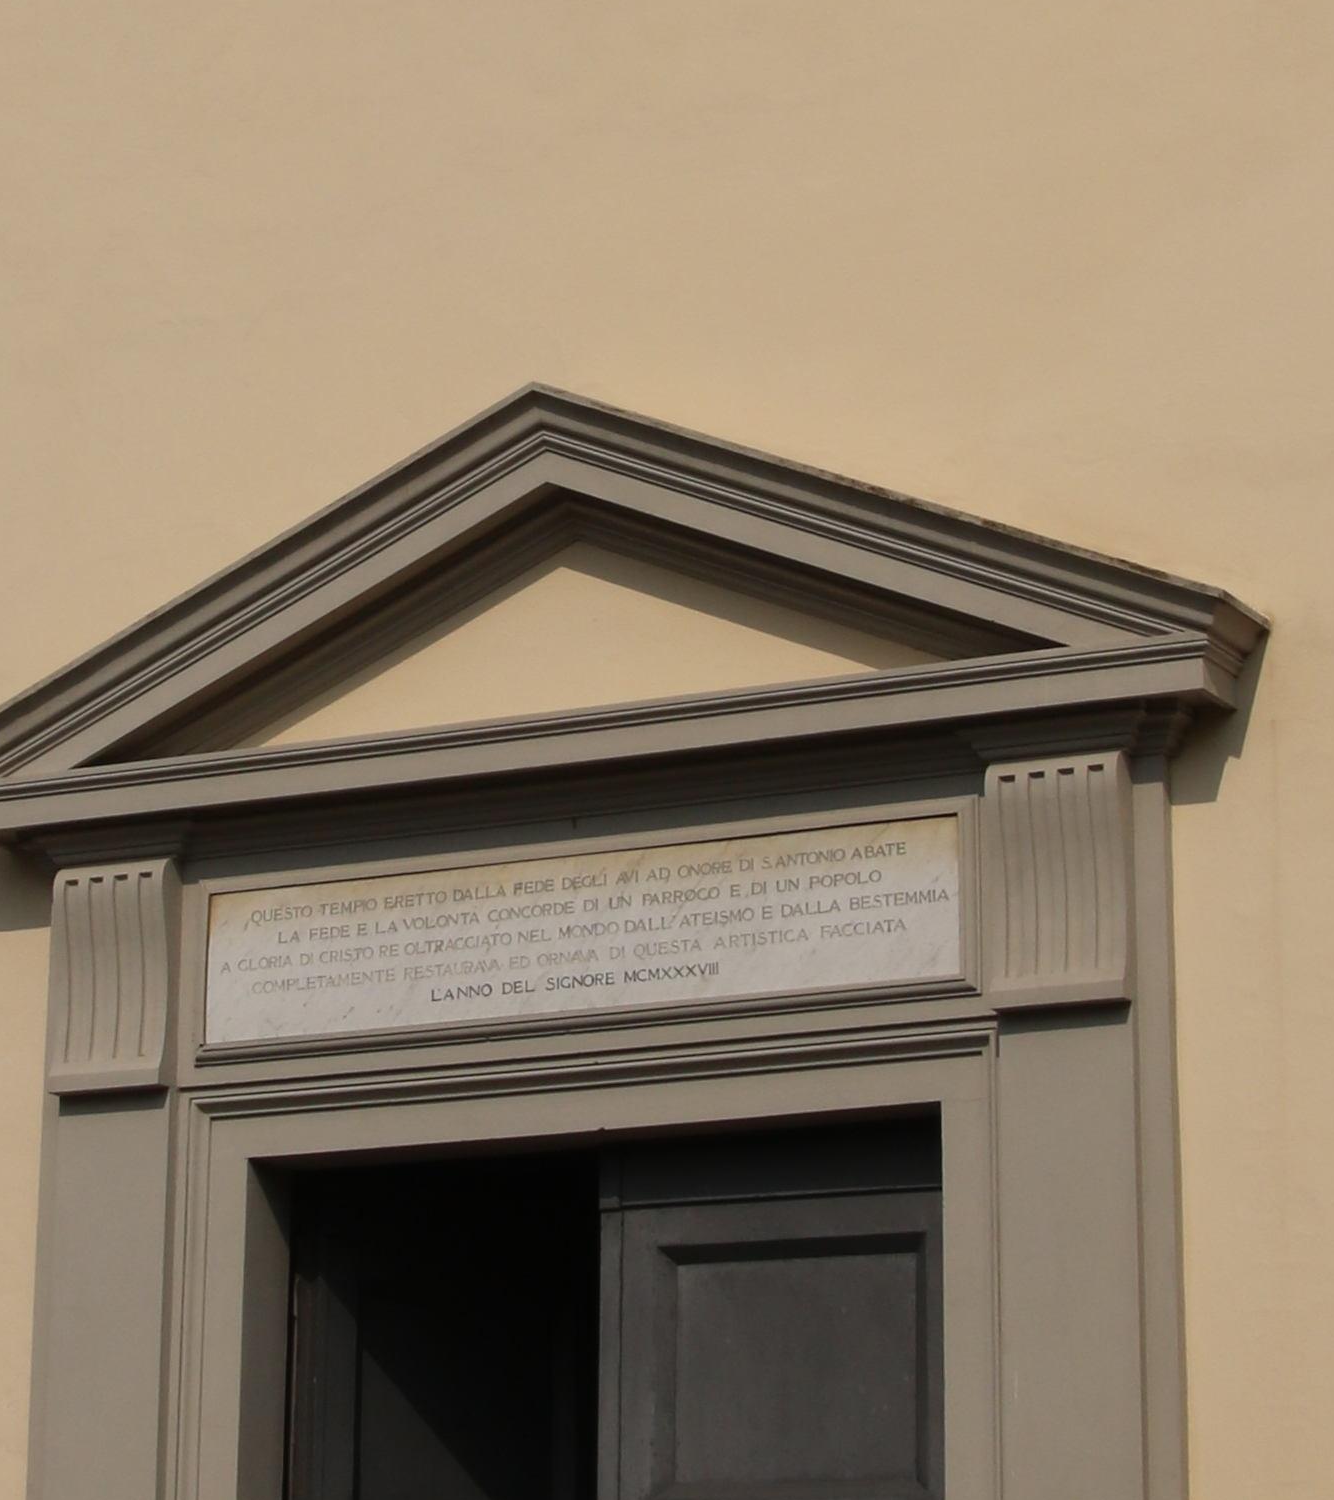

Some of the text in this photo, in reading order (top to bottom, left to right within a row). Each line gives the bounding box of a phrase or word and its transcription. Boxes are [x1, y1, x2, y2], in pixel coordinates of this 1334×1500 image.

[251, 905, 313, 926] QUESTO
[319, 898, 377, 916] TEMPIO
[384, 891, 447, 909] ERETTO
[453, 885, 506, 902] DALLA
[513, 878, 555, 895] FEDE
[562, 873, 607, 891] DEGLI
[616, 869, 639, 885] AVI
[646, 866, 671, 881] AD
[677, 860, 733, 878] ONORE
[739, 857, 754, 872] DI
[851, 842, 907, 860] ABATE
[278, 929, 300, 944] LA
[309, 924, 350, 941] FEDE
[357, 923, 368, 937] E
[375, 920, 398, 934] LA
[487, 900, 575, 923] CONCORDE
[583, 898, 599, 913] DI
[609, 895, 632, 910] UN
[642, 887, 720, 907] PARROCO
[730, 884, 741, 898] E
[751, 881, 767, 896] DI
[776, 878, 800, 893] UN
[809, 869, 882, 890] POPOLO
[220, 962, 232, 974] A
[300, 952, 314, 966] DI
[319, 946, 374, 963] CRISTO
[379, 943, 399, 957] RE
[517, 929, 552, 944] NEL
[558, 921, 619, 939] MONDO
[679, 907, 755, 928] ATEISMO
[762, 905, 773, 920] E
[781, 899, 841, 918] DALLA
[849, 889, 950, 911] BESTEMMIA
[251, 968, 395, 995] COMPLETAMENTE
[509, 955, 531, 970] ED
[538, 949, 599, 967] ORNAVA
[610, 946, 625, 960] DI
[633, 938, 702, 960] QUESTA
[713, 928, 809, 949] ARTISTICA
[820, 918, 907, 939] FACCIATA
[502, 980, 535, 995] DEL
[546, 972, 615, 991] SIGNORE
[624, 962, 719, 983] MCMXXXVIII
